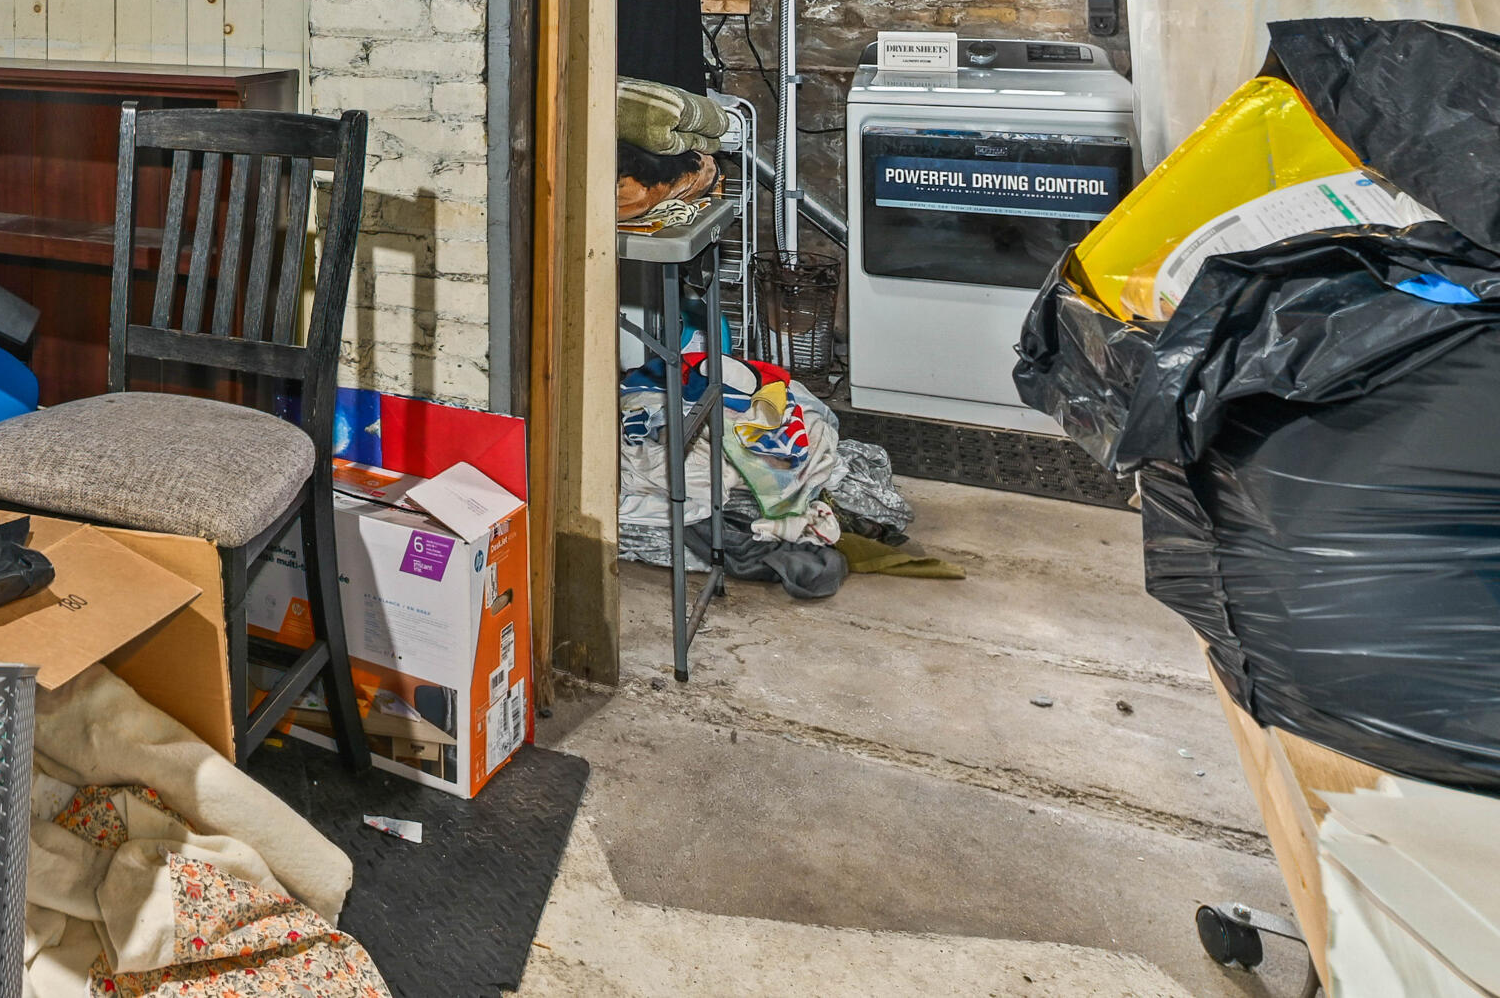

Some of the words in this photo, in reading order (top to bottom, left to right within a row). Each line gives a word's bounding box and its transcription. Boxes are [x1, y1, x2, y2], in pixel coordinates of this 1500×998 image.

[886, 44, 915, 53] DRYER
[915, 45, 949, 54] SHEETS
[885, 168, 967, 188] POWERFUL
[972, 173, 1029, 191] DRYING
[1035, 177, 1109, 196] CONTROL
[413, 536, 424, 553] 6
[58, 593, 88, 612] 180
